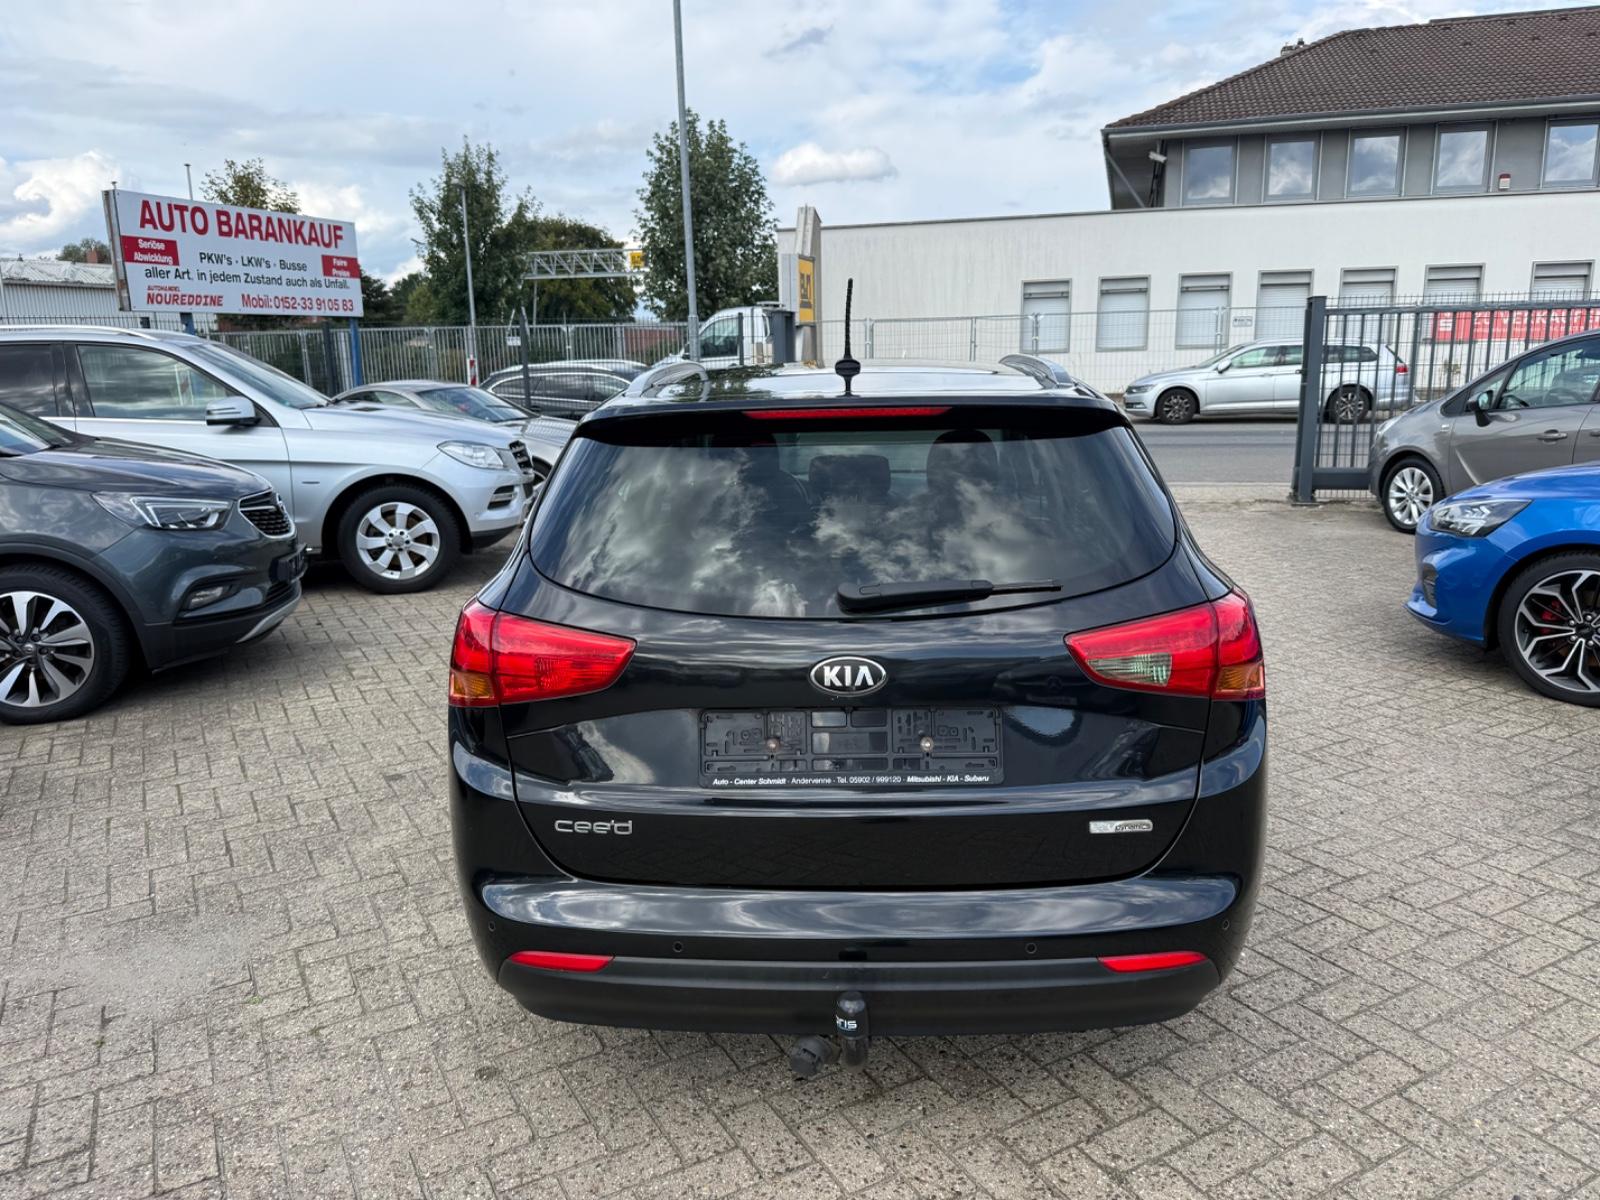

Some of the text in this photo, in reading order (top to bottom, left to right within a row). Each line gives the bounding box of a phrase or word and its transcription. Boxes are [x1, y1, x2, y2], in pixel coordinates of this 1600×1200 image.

[139, 200, 344, 249] AUTO BARANKAUF
[138, 239, 166, 250] Seriöse
[134, 251, 173, 265] Abwicklung
[199, 252, 308, 271] PKW's LKW's Busse
[144, 267, 170, 279] aller
[197, 269, 206, 281] in
[209, 270, 241, 284] jedem
[244, 272, 282, 286] Zustand
[286, 276, 307, 287] auch
[310, 279, 322, 289] als
[147, 293, 224, 307] NOUREDDINE
[823, 665, 874, 687] KIA
[758, 777, 786, 785] Schmidt
[837, 776, 848, 784] Tel.
[907, 775, 942, 783] Mitsubishi
[947, 775, 959, 783] KIA
[964, 775, 990, 783] Subaru
[554, 819, 633, 835] cee'd
